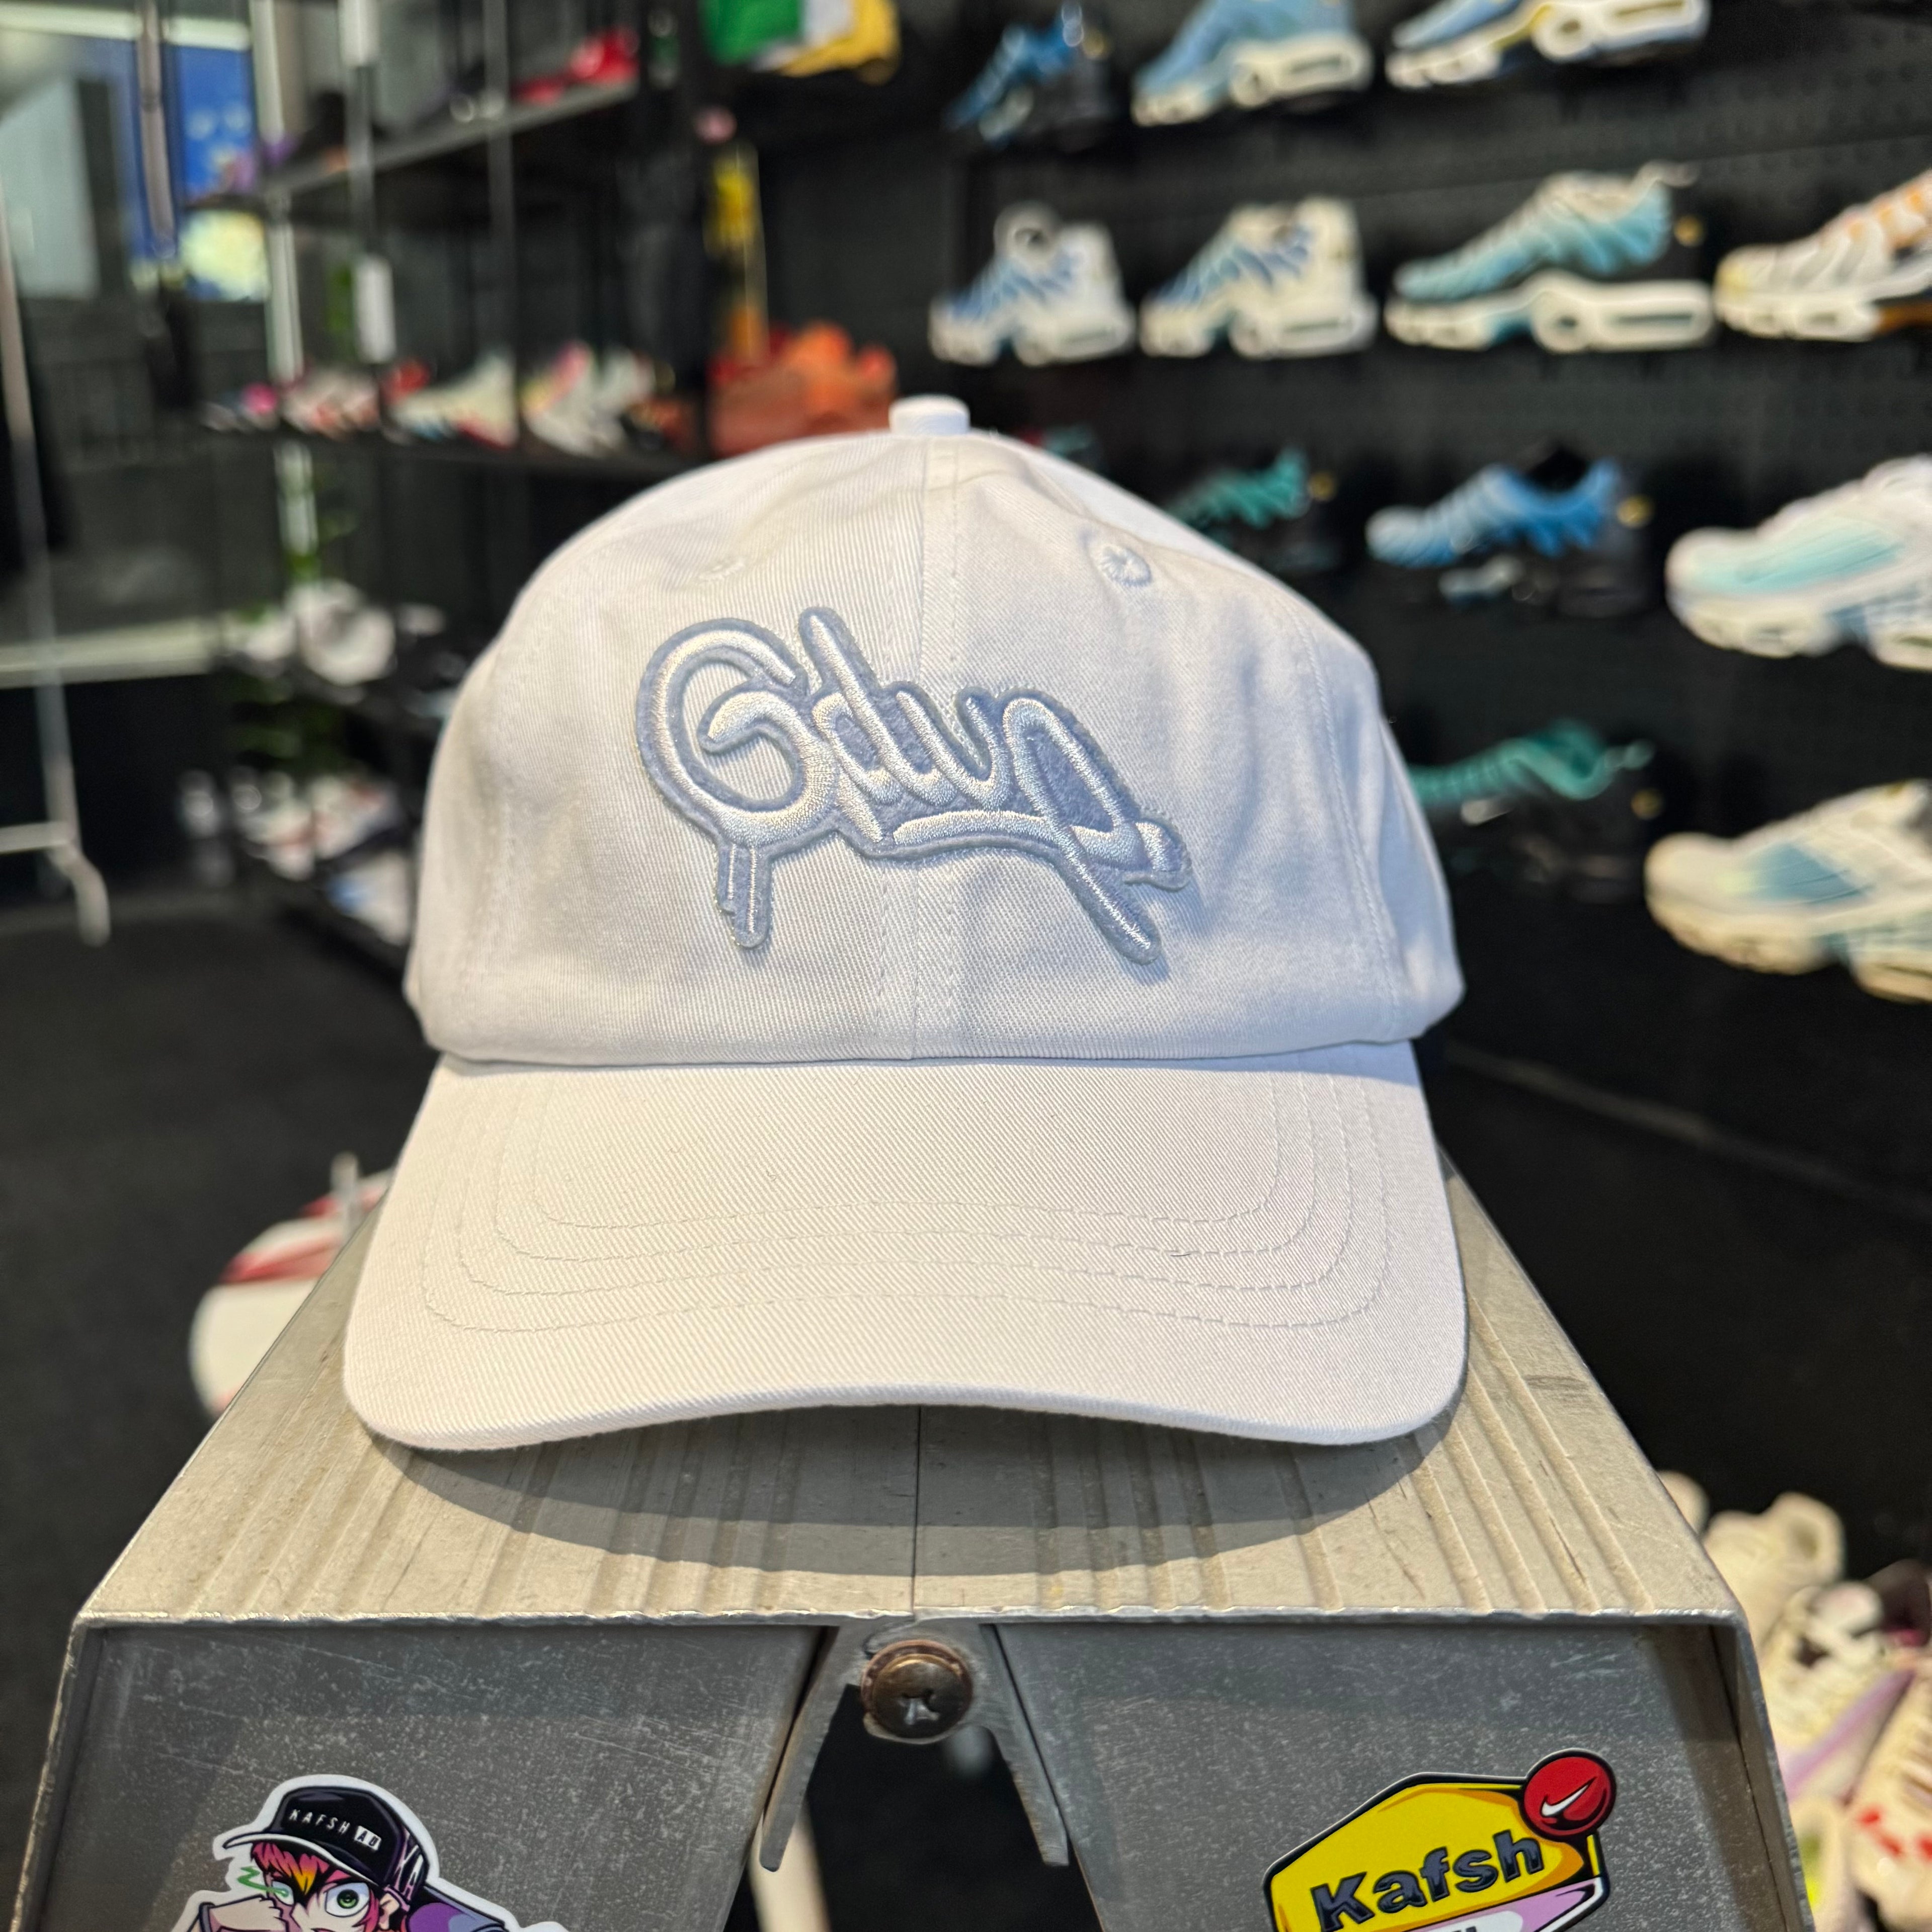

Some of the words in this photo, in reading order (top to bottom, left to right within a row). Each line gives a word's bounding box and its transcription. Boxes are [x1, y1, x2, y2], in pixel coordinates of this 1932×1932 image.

[289, 1809, 351, 1834] KAFSH
[357, 1830, 378, 1846] AU
[1310, 1829, 1544, 1932] Kafsh
